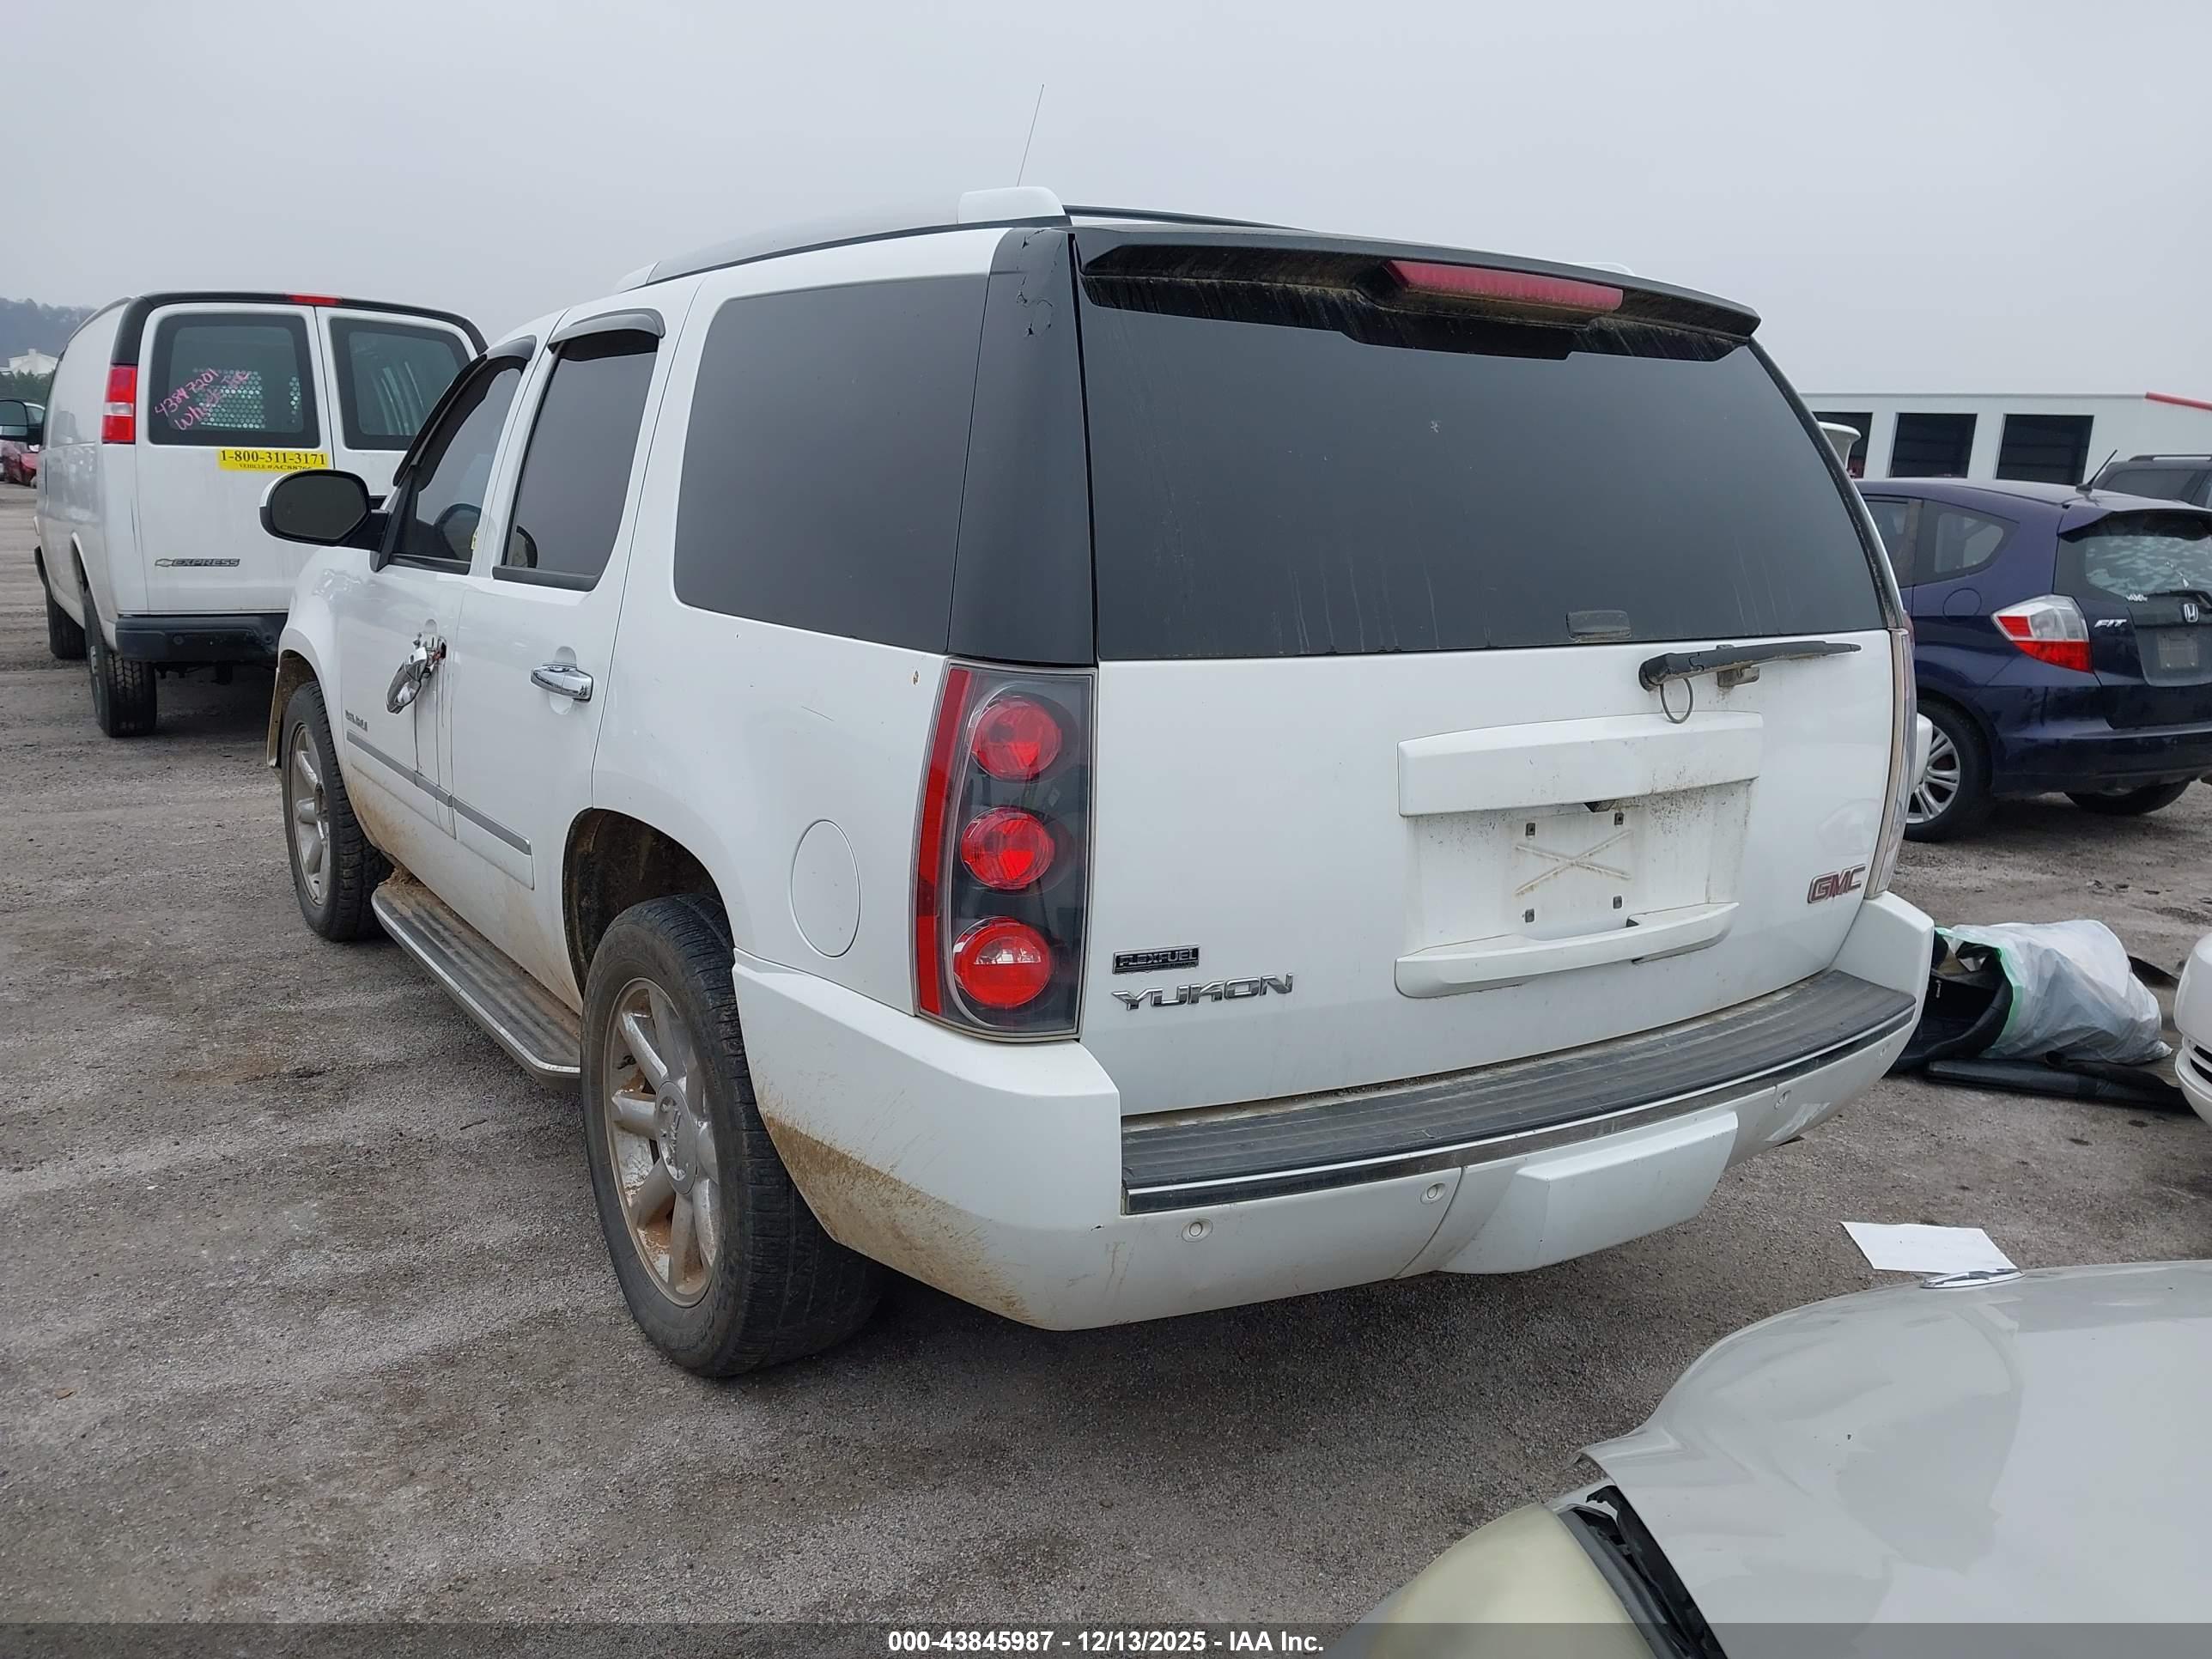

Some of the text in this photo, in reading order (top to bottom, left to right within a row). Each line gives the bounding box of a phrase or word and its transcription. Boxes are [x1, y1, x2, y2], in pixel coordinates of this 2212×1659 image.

[221, 450, 325, 465] 1-800-311-3171
[172, 558, 240, 568] EXPRESS
[2094, 619, 2128, 628] FIT
[1807, 863, 1866, 903] GMC
[1119, 948, 1197, 966] FLEXFUEL
[1111, 973, 1294, 1011] YUKON
